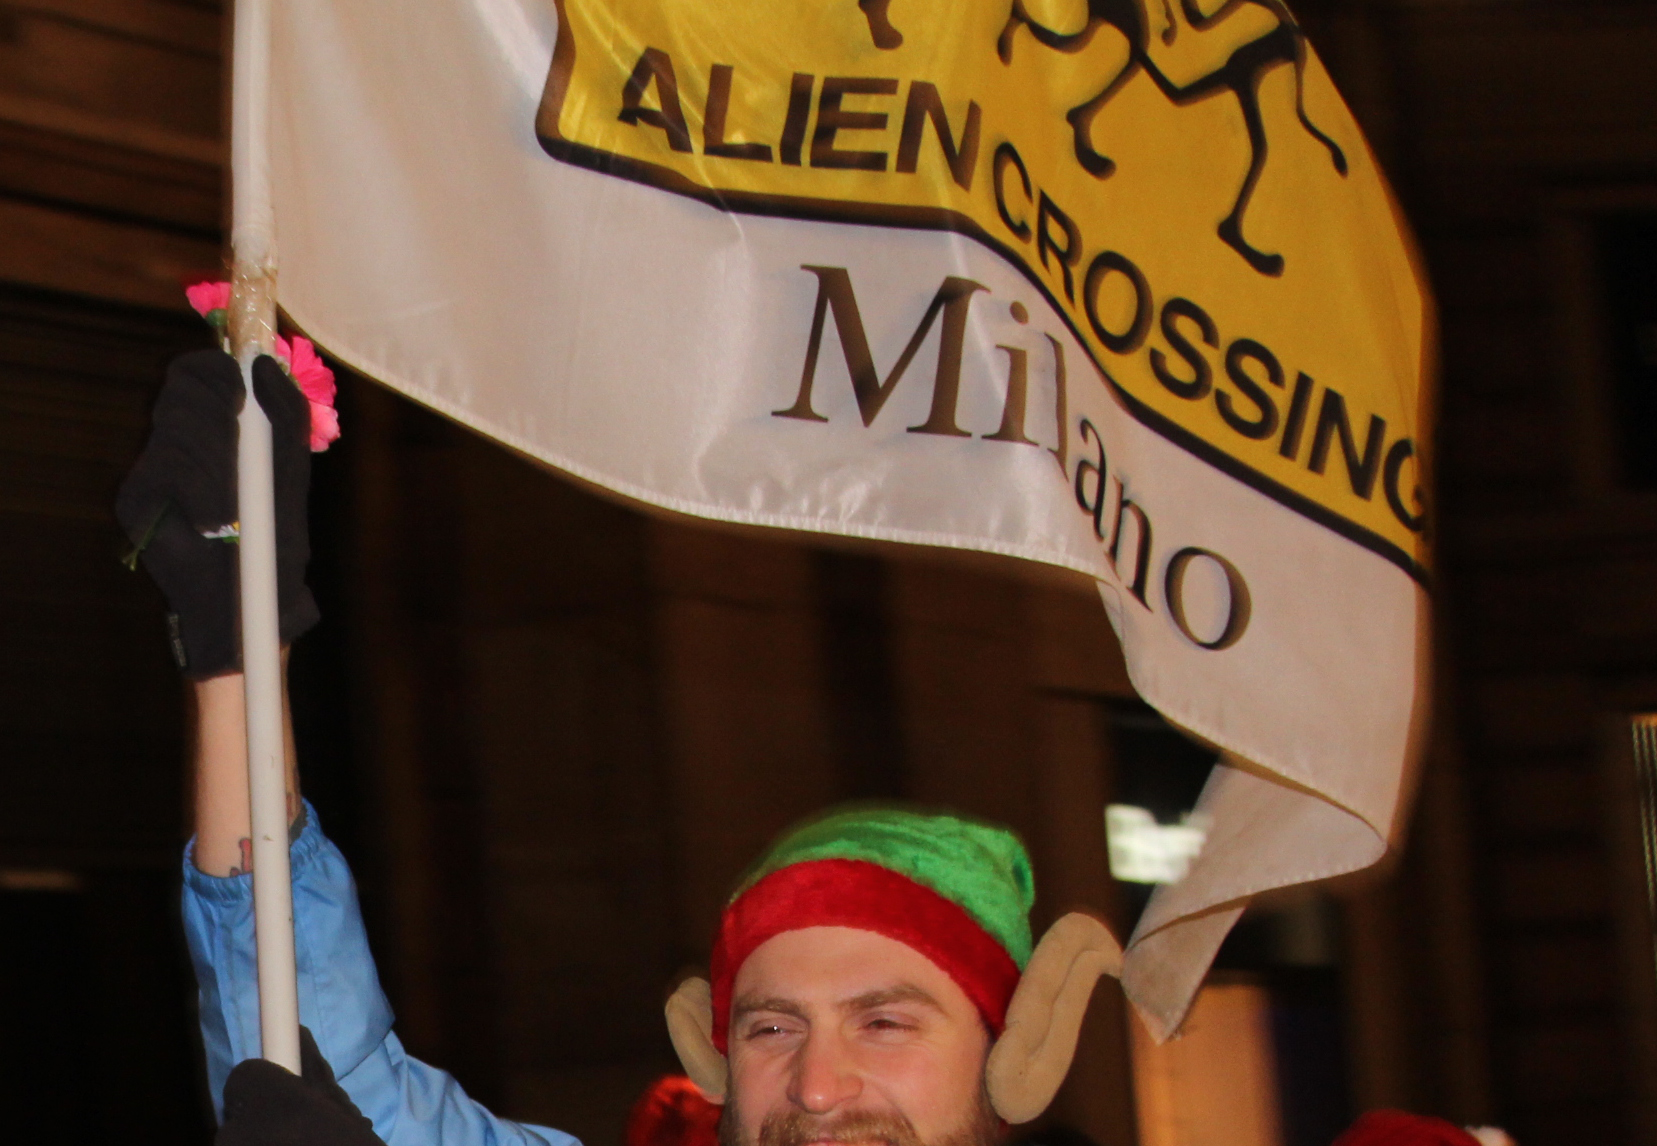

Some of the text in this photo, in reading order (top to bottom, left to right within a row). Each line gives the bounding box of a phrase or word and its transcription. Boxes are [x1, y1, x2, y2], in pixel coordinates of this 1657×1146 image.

[618, 46, 1428, 532] ALIEN CROSSING
[771, 264, 1252, 651] Milano
